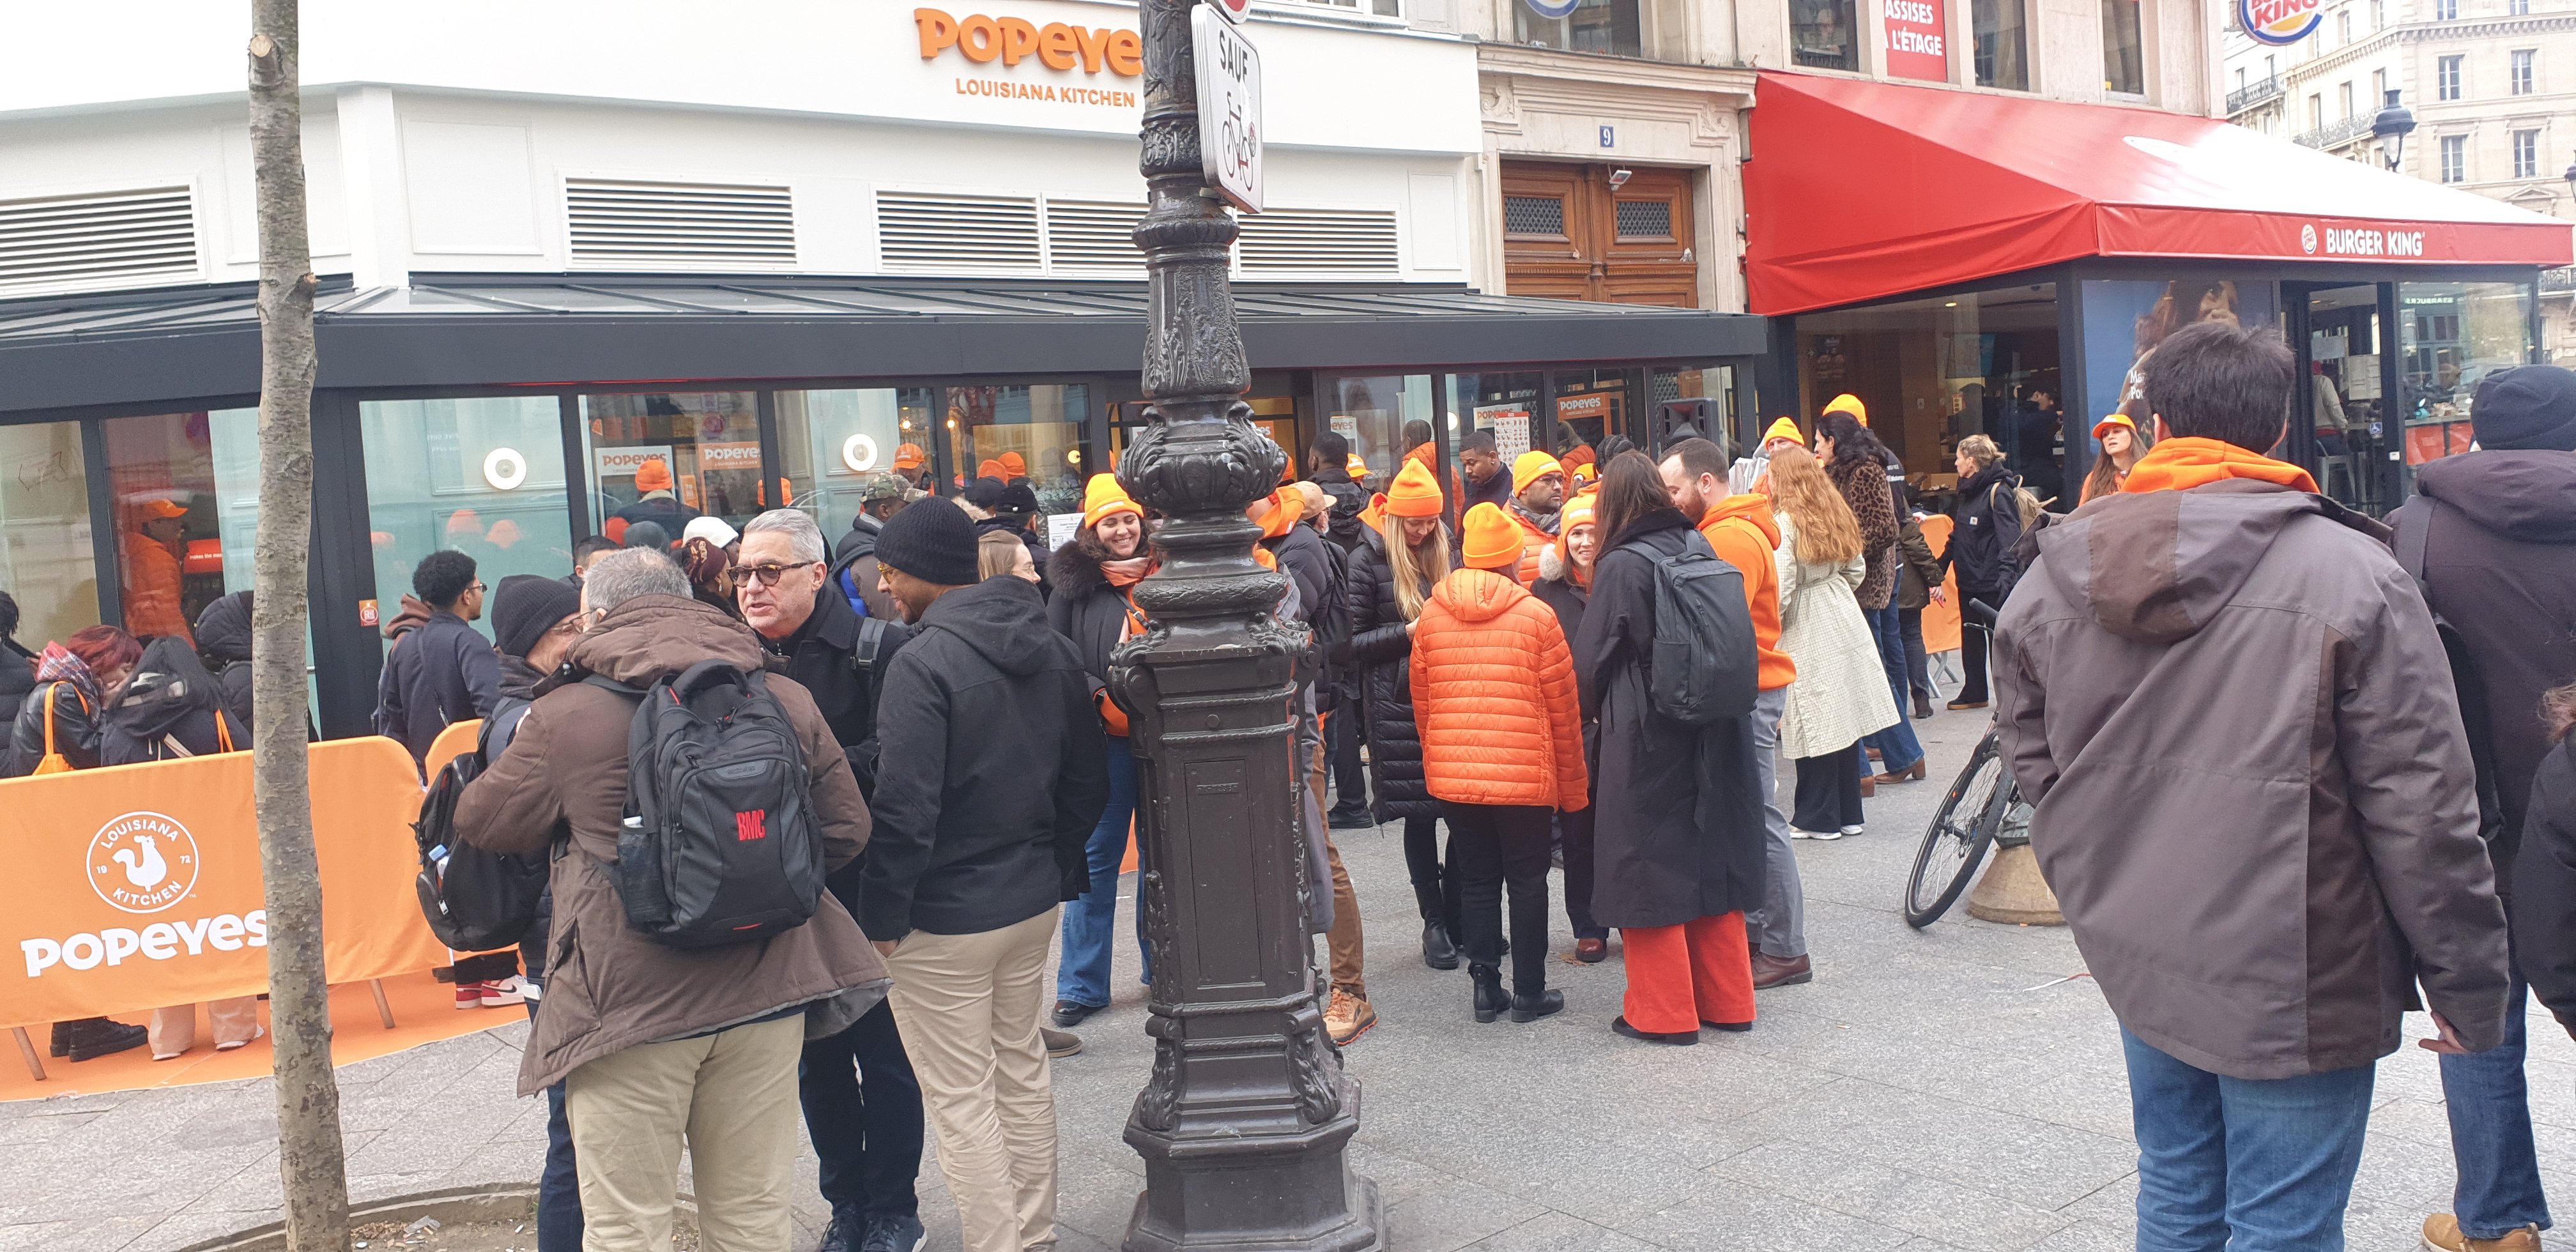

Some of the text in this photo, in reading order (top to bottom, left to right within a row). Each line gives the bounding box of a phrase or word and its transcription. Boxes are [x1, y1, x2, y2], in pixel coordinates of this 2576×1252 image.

[1885, 0, 1933, 24] ASSISES
[914, 8, 1144, 77] POPEYE
[1892, 26, 1943, 56] L'ÉTAGE
[1219, 29, 1248, 84] SAUF
[956, 78, 1135, 107] LOUISIANA KITCHEN
[1603, 128, 1611, 146] 9
[2326, 227, 2423, 256] BURGER KING
[704, 447, 760, 461] POPEYE
[100, 818, 178, 849] LOUISIANA
[736, 809, 766, 841] BMC
[96, 855, 191, 874] 19 72
[112, 880, 182, 906] KITCHEN
